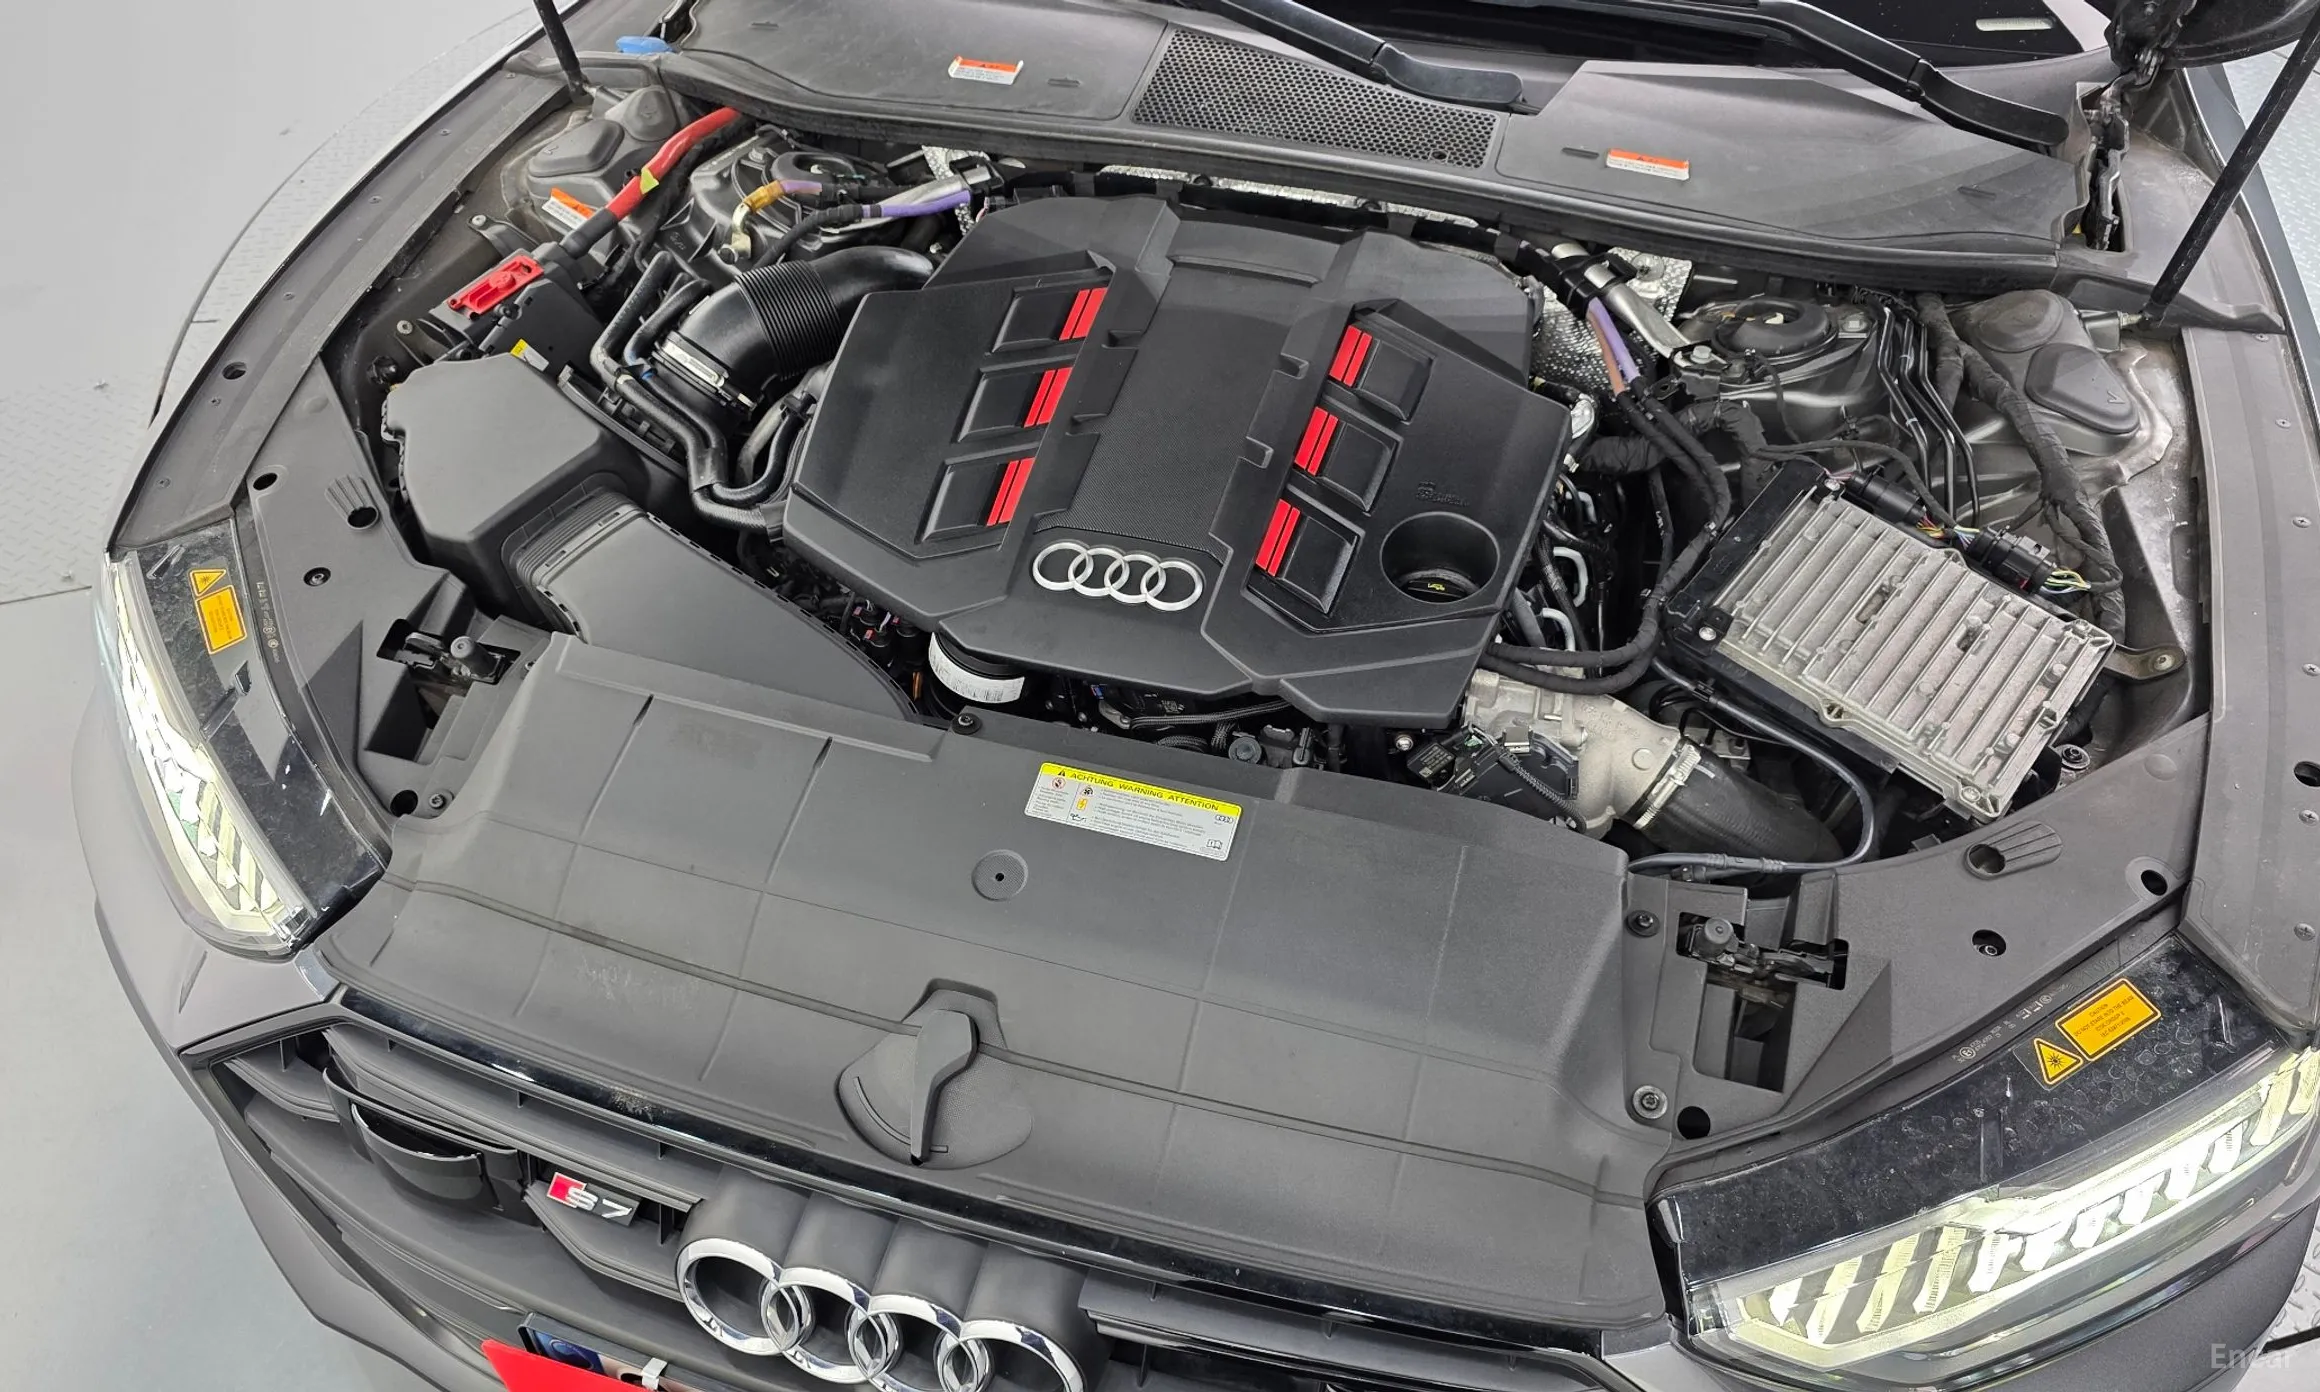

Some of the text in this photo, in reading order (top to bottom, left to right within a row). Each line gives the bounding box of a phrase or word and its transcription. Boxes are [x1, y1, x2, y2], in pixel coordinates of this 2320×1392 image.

[1070, 773, 1219, 811] ACHTUNG WARNING ATTENTION
[565, 1187, 633, 1219] S7
